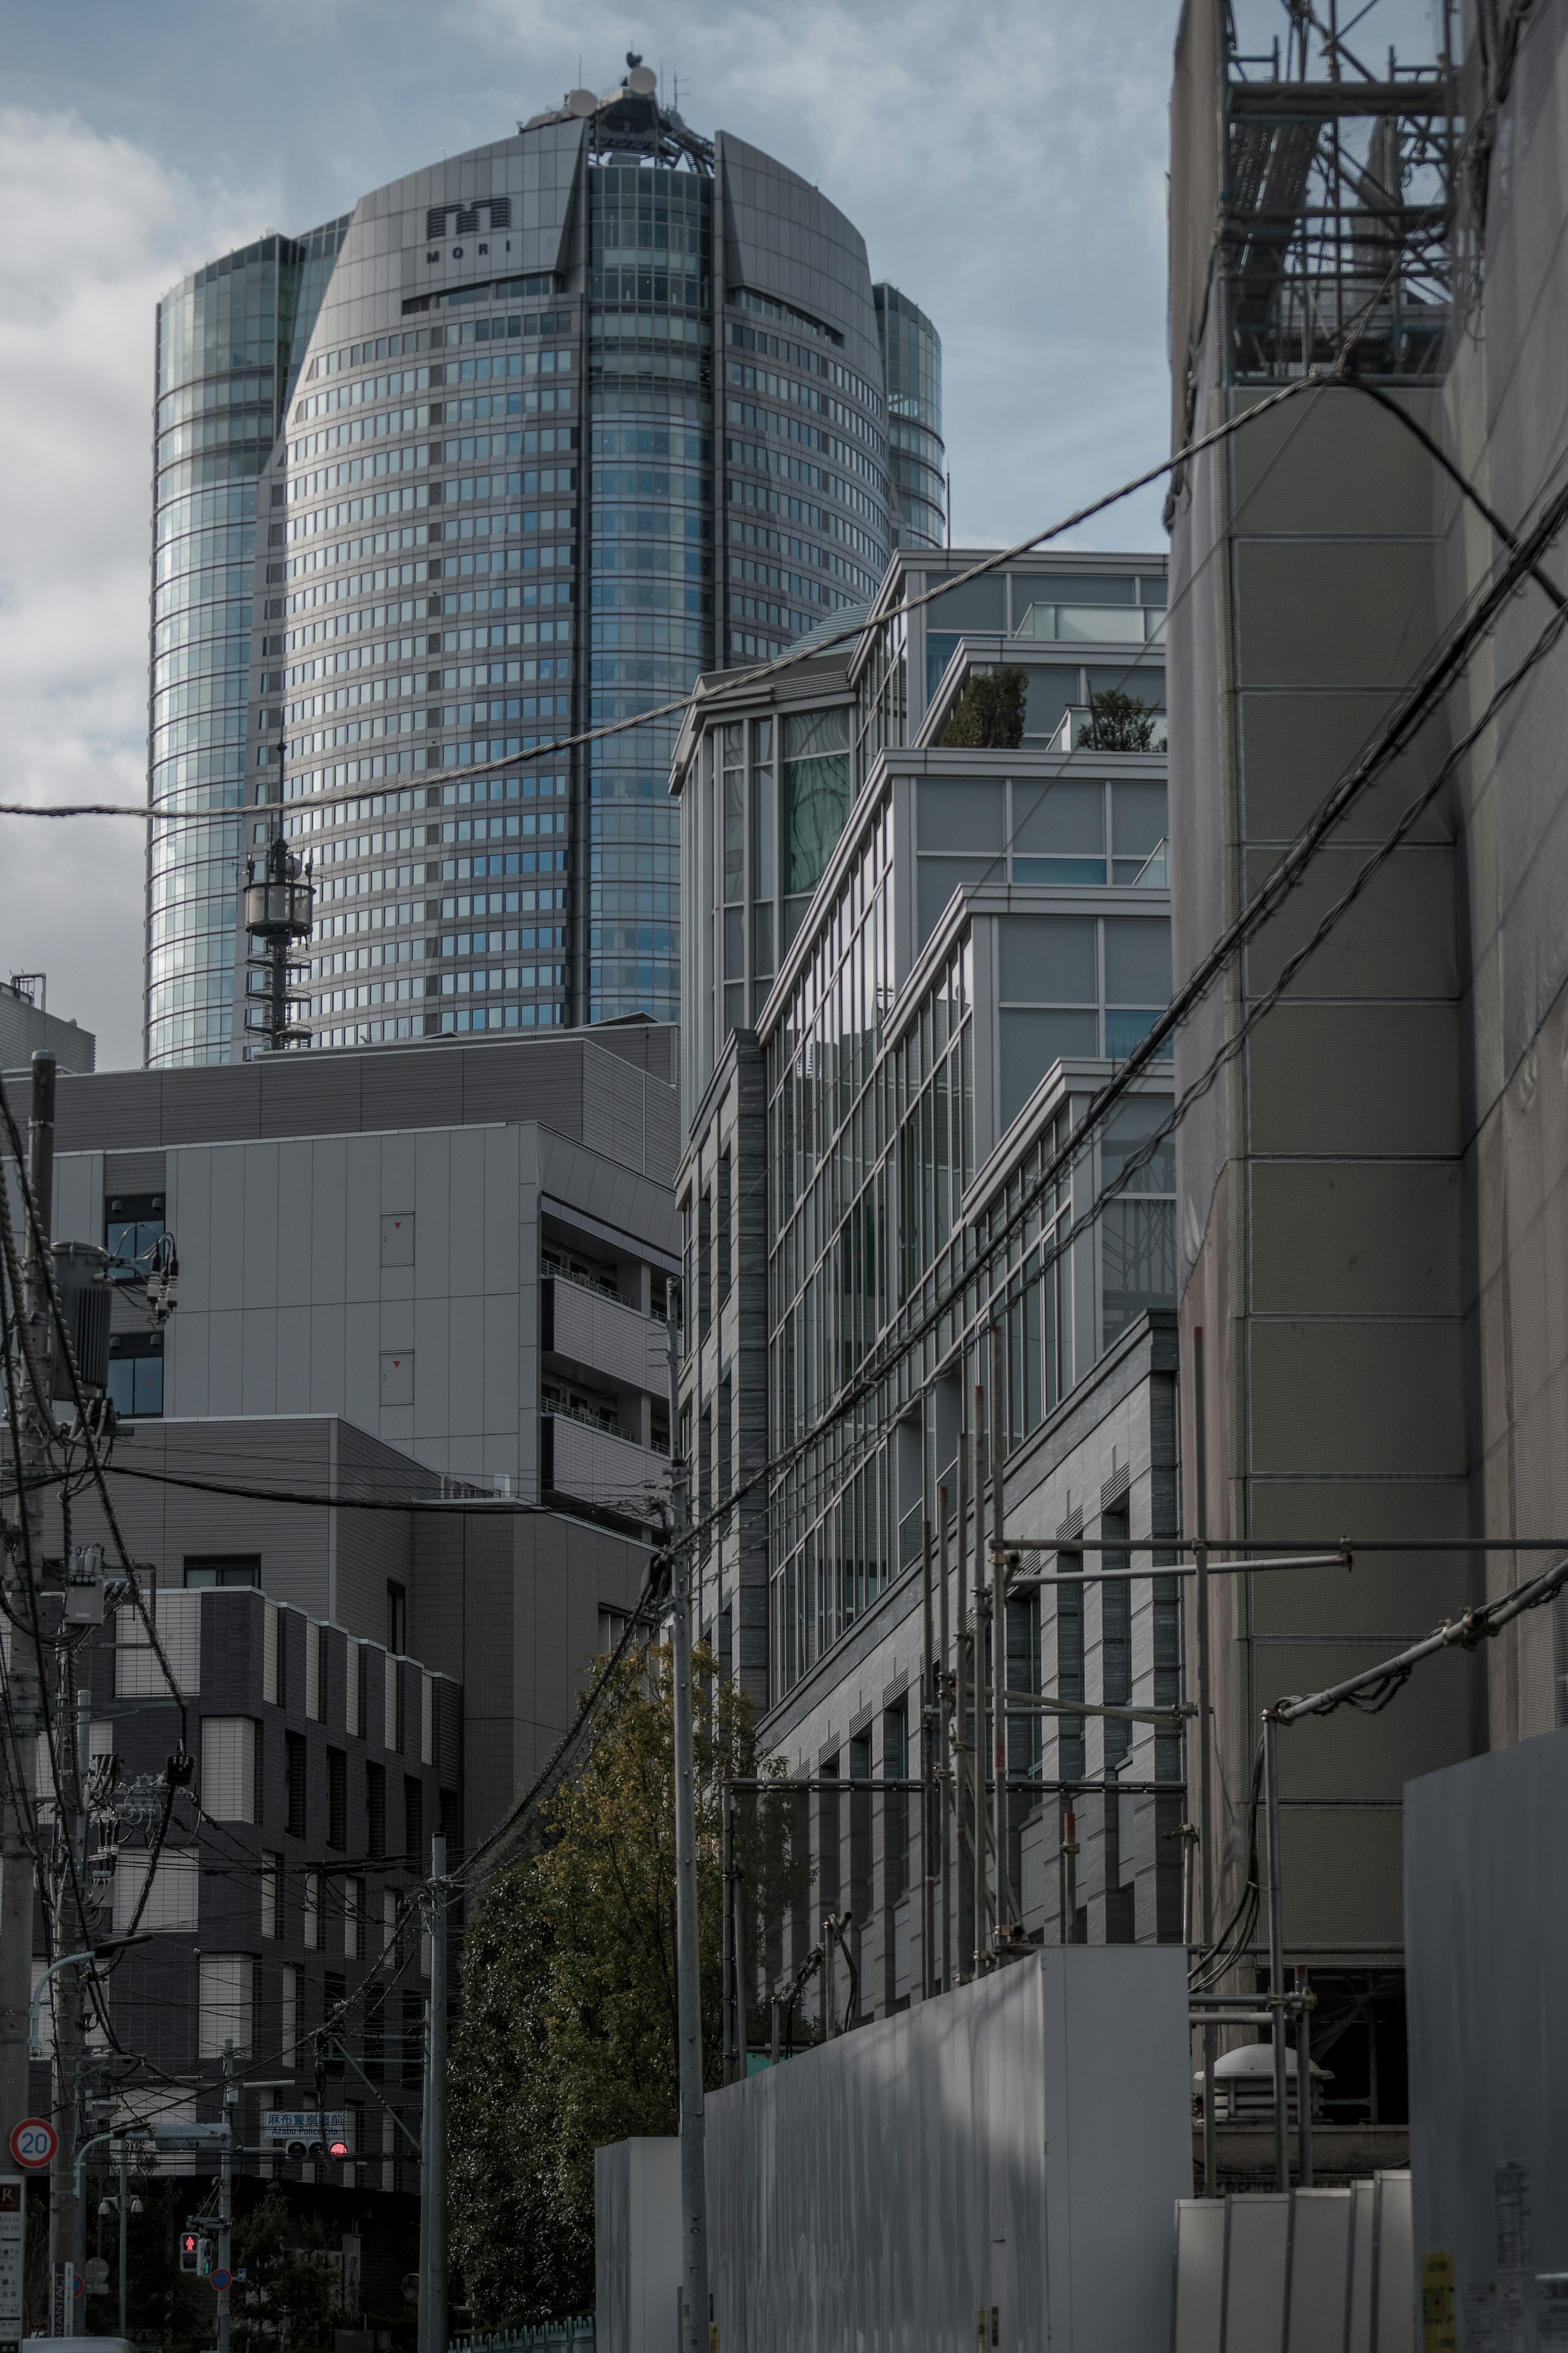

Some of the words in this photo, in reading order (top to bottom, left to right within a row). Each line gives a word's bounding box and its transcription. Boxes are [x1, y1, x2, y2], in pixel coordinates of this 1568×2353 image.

[427, 240, 510, 263] MORI
[22, 2133, 47, 2153] 20
[56, 2271, 64, 2337] RANTACT
